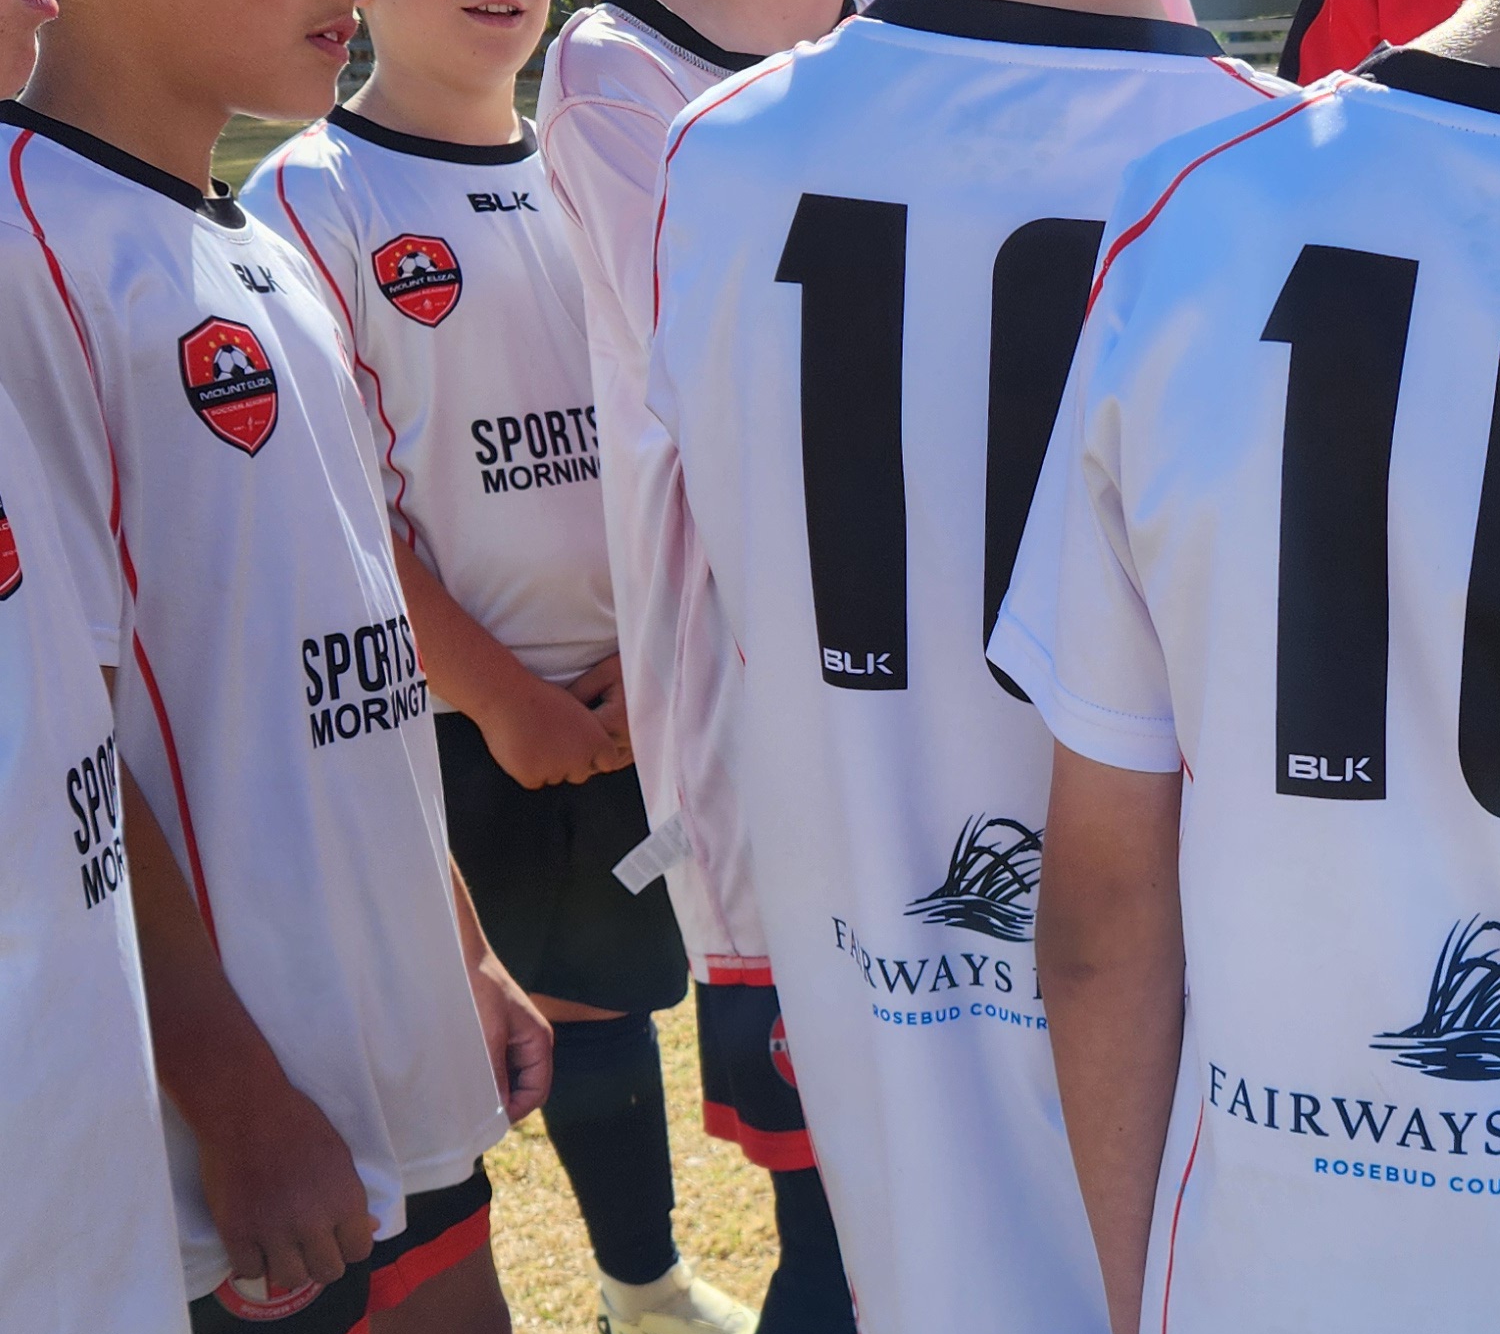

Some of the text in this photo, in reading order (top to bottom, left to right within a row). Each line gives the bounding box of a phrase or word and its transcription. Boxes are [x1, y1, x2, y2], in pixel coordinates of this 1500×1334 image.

[466, 191, 540, 213] BLK
[229, 262, 287, 295] BLK
[200, 377, 272, 401] MOUNT ELIZA
[481, 455, 600, 494] MORNIN
[302, 614, 416, 707] SPORTS
[821, 647, 893, 676] BLK
[1287, 753, 1372, 782] BLK
[1314, 1157, 1436, 1188] ROSEBUD
